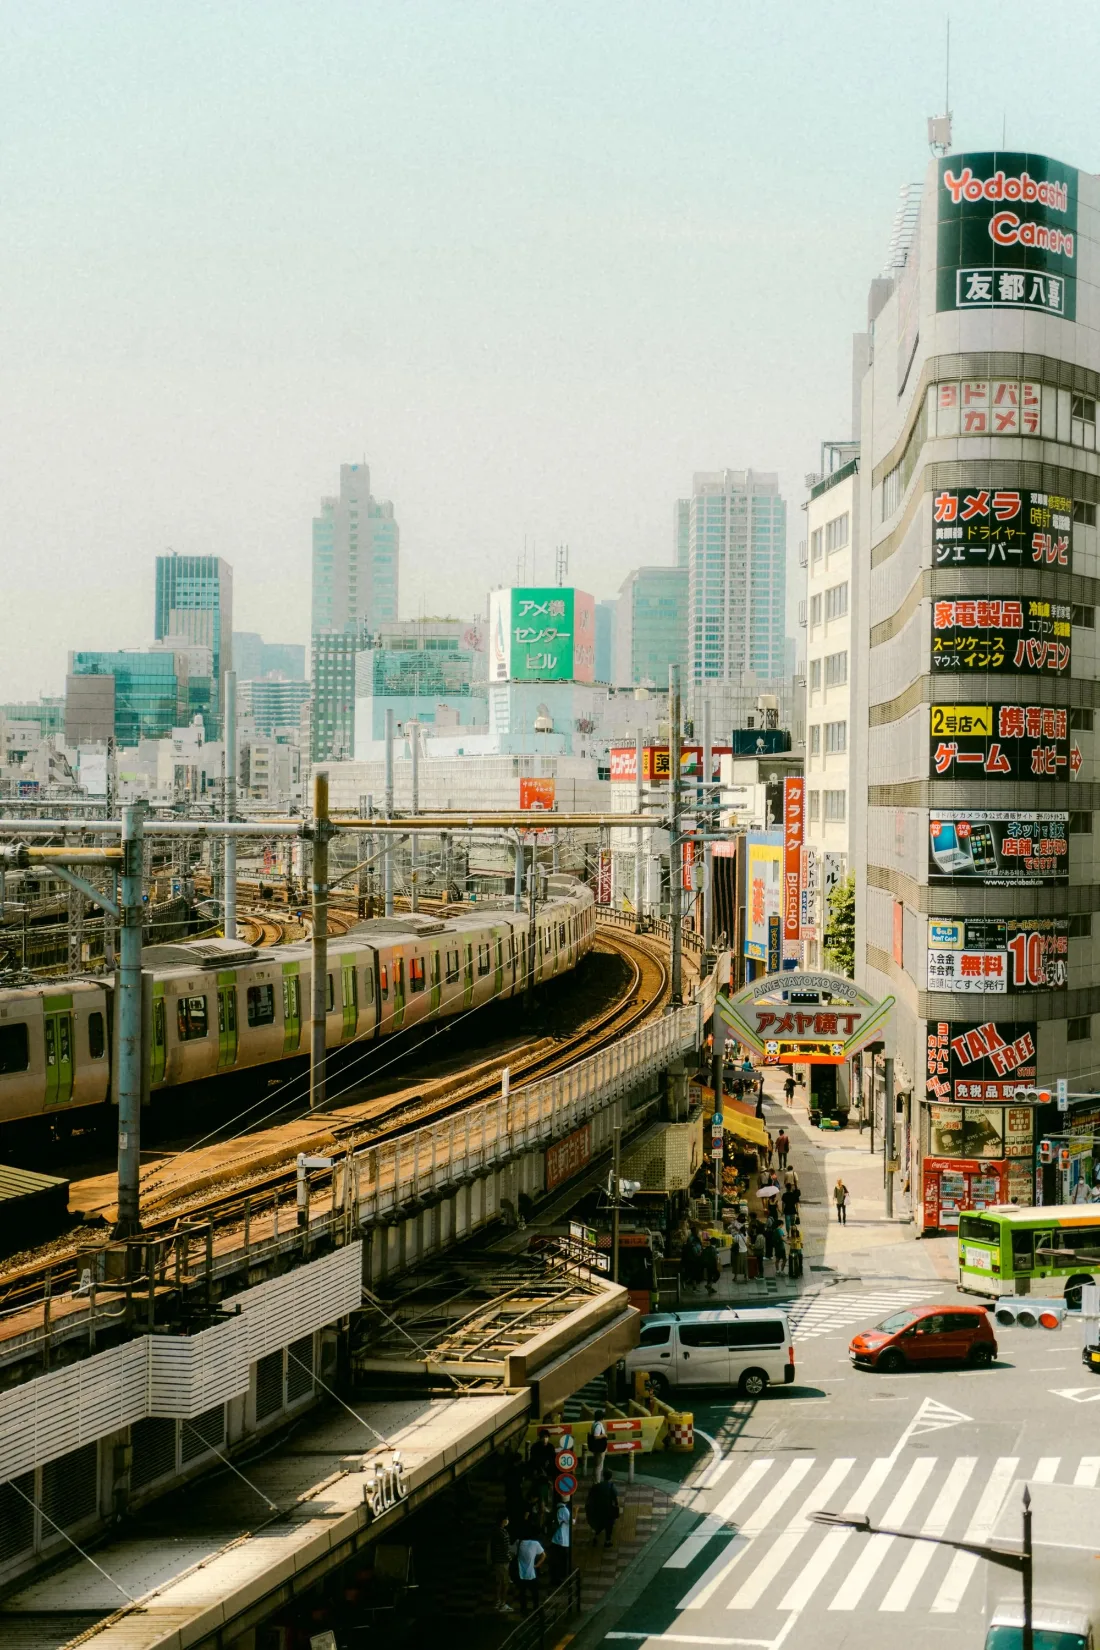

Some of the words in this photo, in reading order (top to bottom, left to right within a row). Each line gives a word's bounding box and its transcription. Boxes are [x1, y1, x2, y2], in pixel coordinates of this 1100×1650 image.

[944, 168, 1068, 213] Yodobashi
[988, 210, 1073, 258] Camera
[965, 272, 1061, 309] 友都八喜
[938, 382, 1038, 408] ヨドバシ
[964, 409, 1039, 432] カメラ
[933, 490, 1022, 522] カメラ
[1030, 507, 1051, 528] 時計
[967, 526, 1027, 541] ドライヤー
[935, 541, 1023, 562] シェーバー
[1031, 532, 1070, 565] テレビ
[518, 599, 565, 617] アメ横
[934, 600, 1024, 629] 家電製品
[514, 627, 571, 643] センター
[1028, 620, 1054, 634] エアコン
[933, 637, 1005, 651] スーツケース
[1013, 637, 1071, 670] パソコン
[526, 653, 557, 670] ビル
[933, 655, 961, 667] マウス
[964, 652, 1005, 667] インク
[933, 708, 988, 734] 2号店へ
[998, 706, 1067, 740] 携帯電話
[934, 742, 1011, 774] ゲーム
[1031, 745, 1067, 775] ホビー
[787, 787, 802, 852] カラオケ
[786, 873, 798, 895] BIG
[786, 897, 798, 930] ECHO
[930, 953, 954, 965] 入会金
[960, 954, 1003, 977] 無料
[930, 965, 954, 977] 年会費
[753, 976, 858, 999] AMEYAYOKOCHO
[929, 978, 1005, 991] 店頭にてすぐ発行
[756, 1012, 861, 1035] アメヤ横丁
[928, 1034, 937, 1075] カメラ
[937, 1022, 949, 1075] ヨドバシ
[951, 1022, 1006, 1067] TAX
[989, 1031, 1036, 1077] FREE
[926, 1075, 940, 1092] TAX
[934, 1082, 950, 1097] FREE
[560, 1456, 573, 1467] 30
